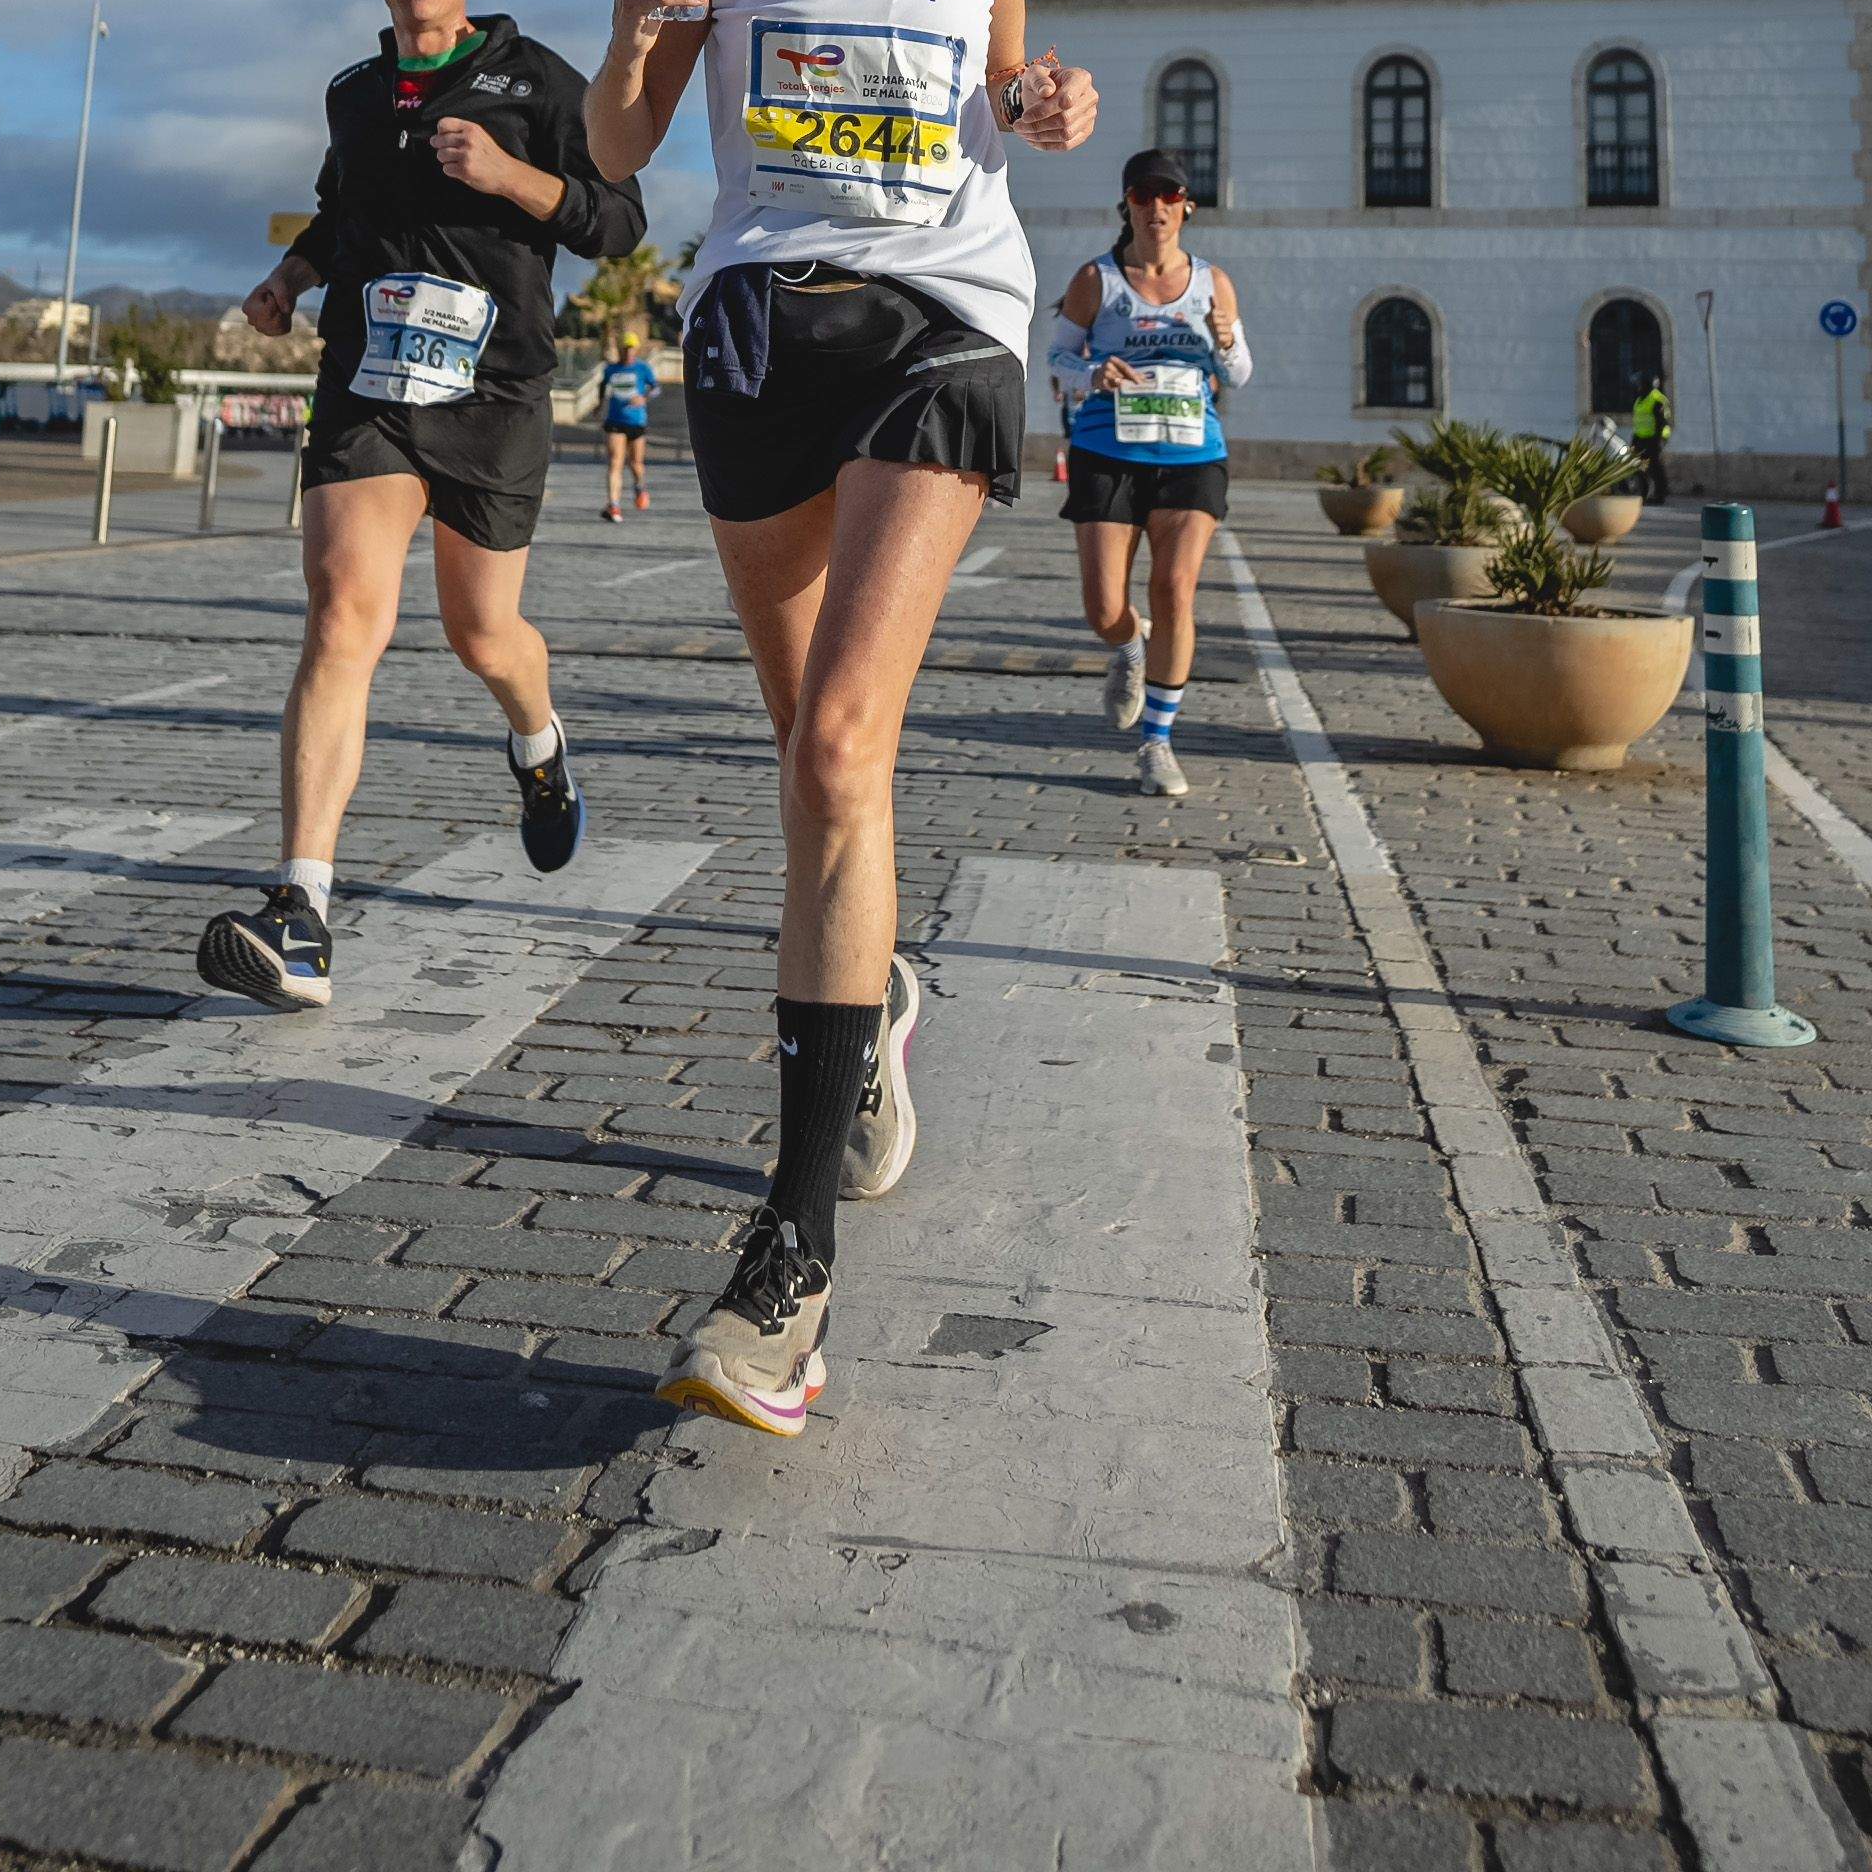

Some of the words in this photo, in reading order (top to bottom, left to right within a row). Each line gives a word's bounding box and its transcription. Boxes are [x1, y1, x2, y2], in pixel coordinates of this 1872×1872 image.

[863, 74, 879, 85] 1/2
[777, 81, 845, 95] TotalEnergies
[862, 87, 877, 97] DE
[792, 110, 926, 166] 2644
[389, 328, 447, 370] 136
